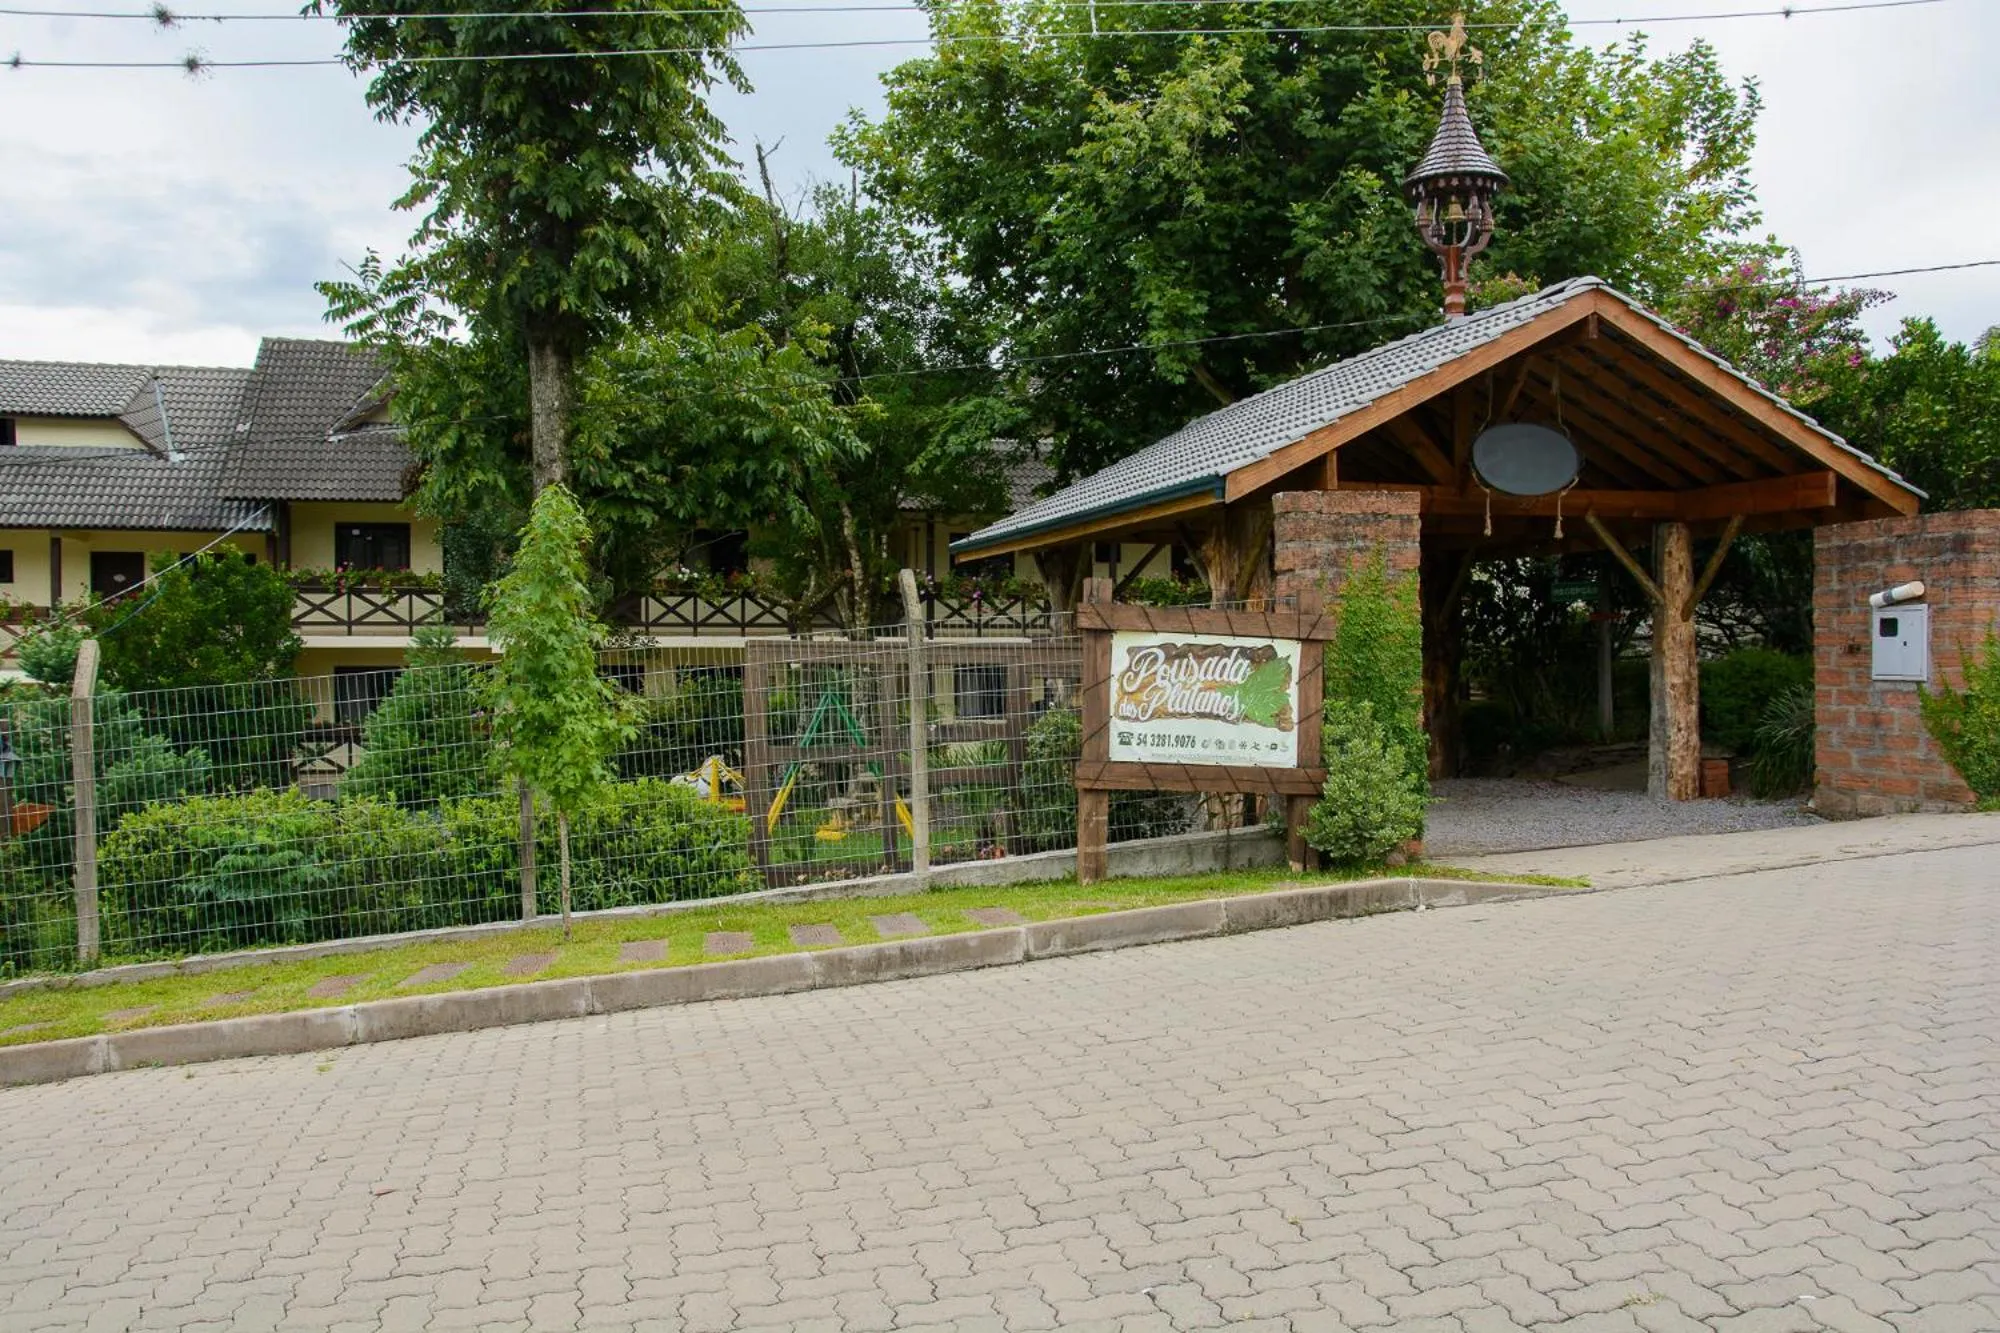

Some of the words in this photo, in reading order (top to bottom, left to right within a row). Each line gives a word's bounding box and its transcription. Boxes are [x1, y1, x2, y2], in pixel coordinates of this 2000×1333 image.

[1122, 647, 1252, 692] Pousada
[1136, 733, 1148, 747] 54
[1150, 733, 1197, 750] 3281.9076
